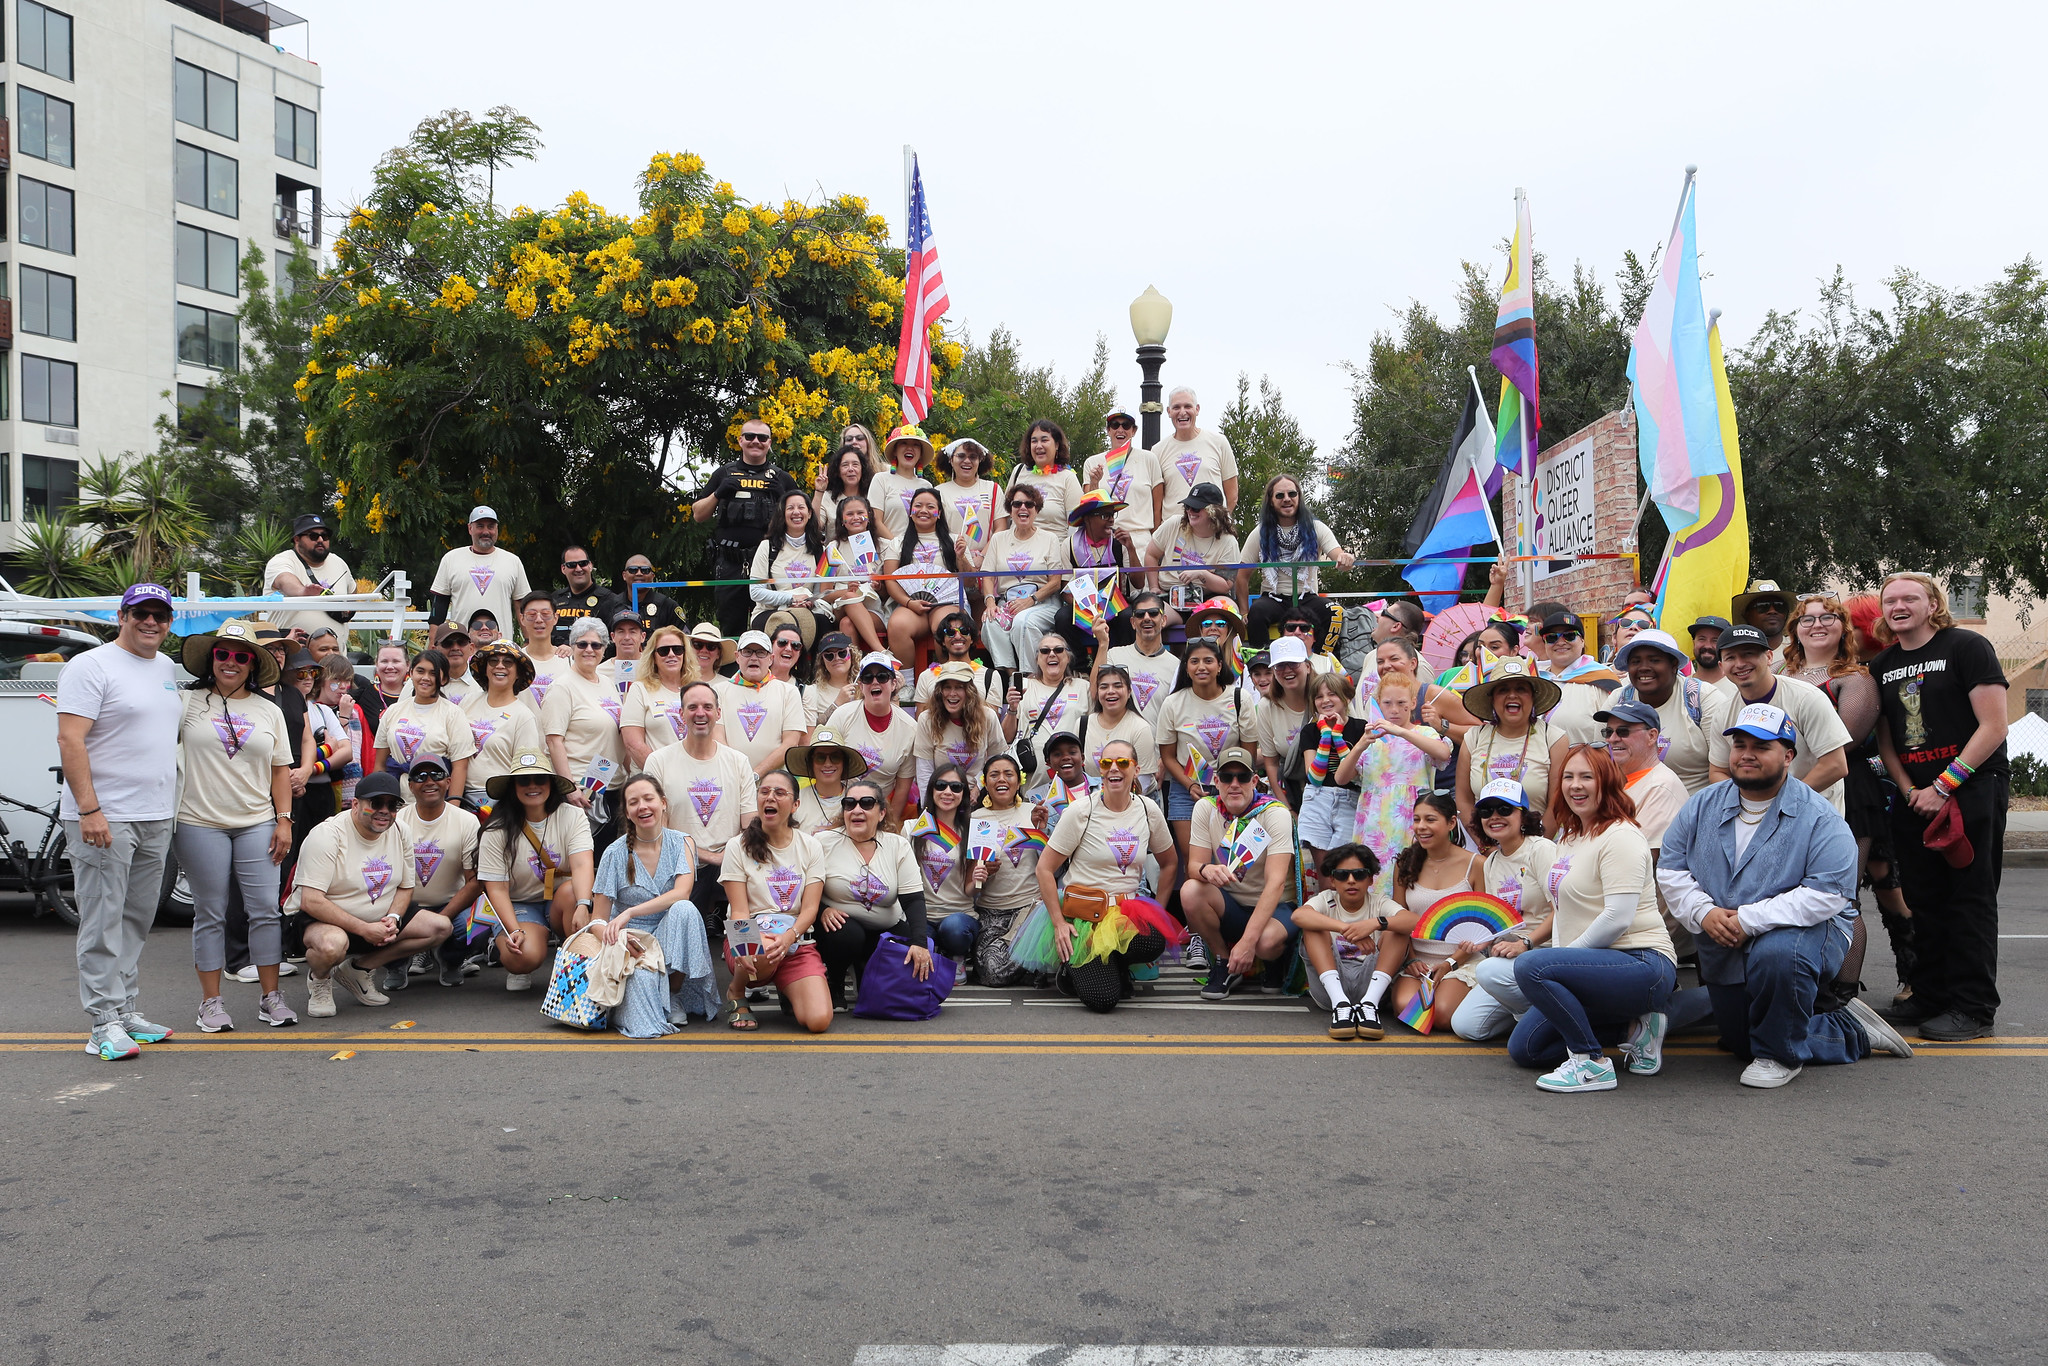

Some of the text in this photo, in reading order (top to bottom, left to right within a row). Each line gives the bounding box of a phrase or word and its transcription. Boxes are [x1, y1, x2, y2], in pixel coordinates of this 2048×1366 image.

[1547, 452, 1585, 495] DISTRICT
[738, 478, 770, 489] OLIC
[1547, 487, 1579, 524] QUEER
[1548, 513, 1593, 555] ALLIANCE
[134, 586, 167, 599] SDCCE
[1732, 629, 1760, 638] SDCCE
[1742, 708, 1776, 719] SDCCE
